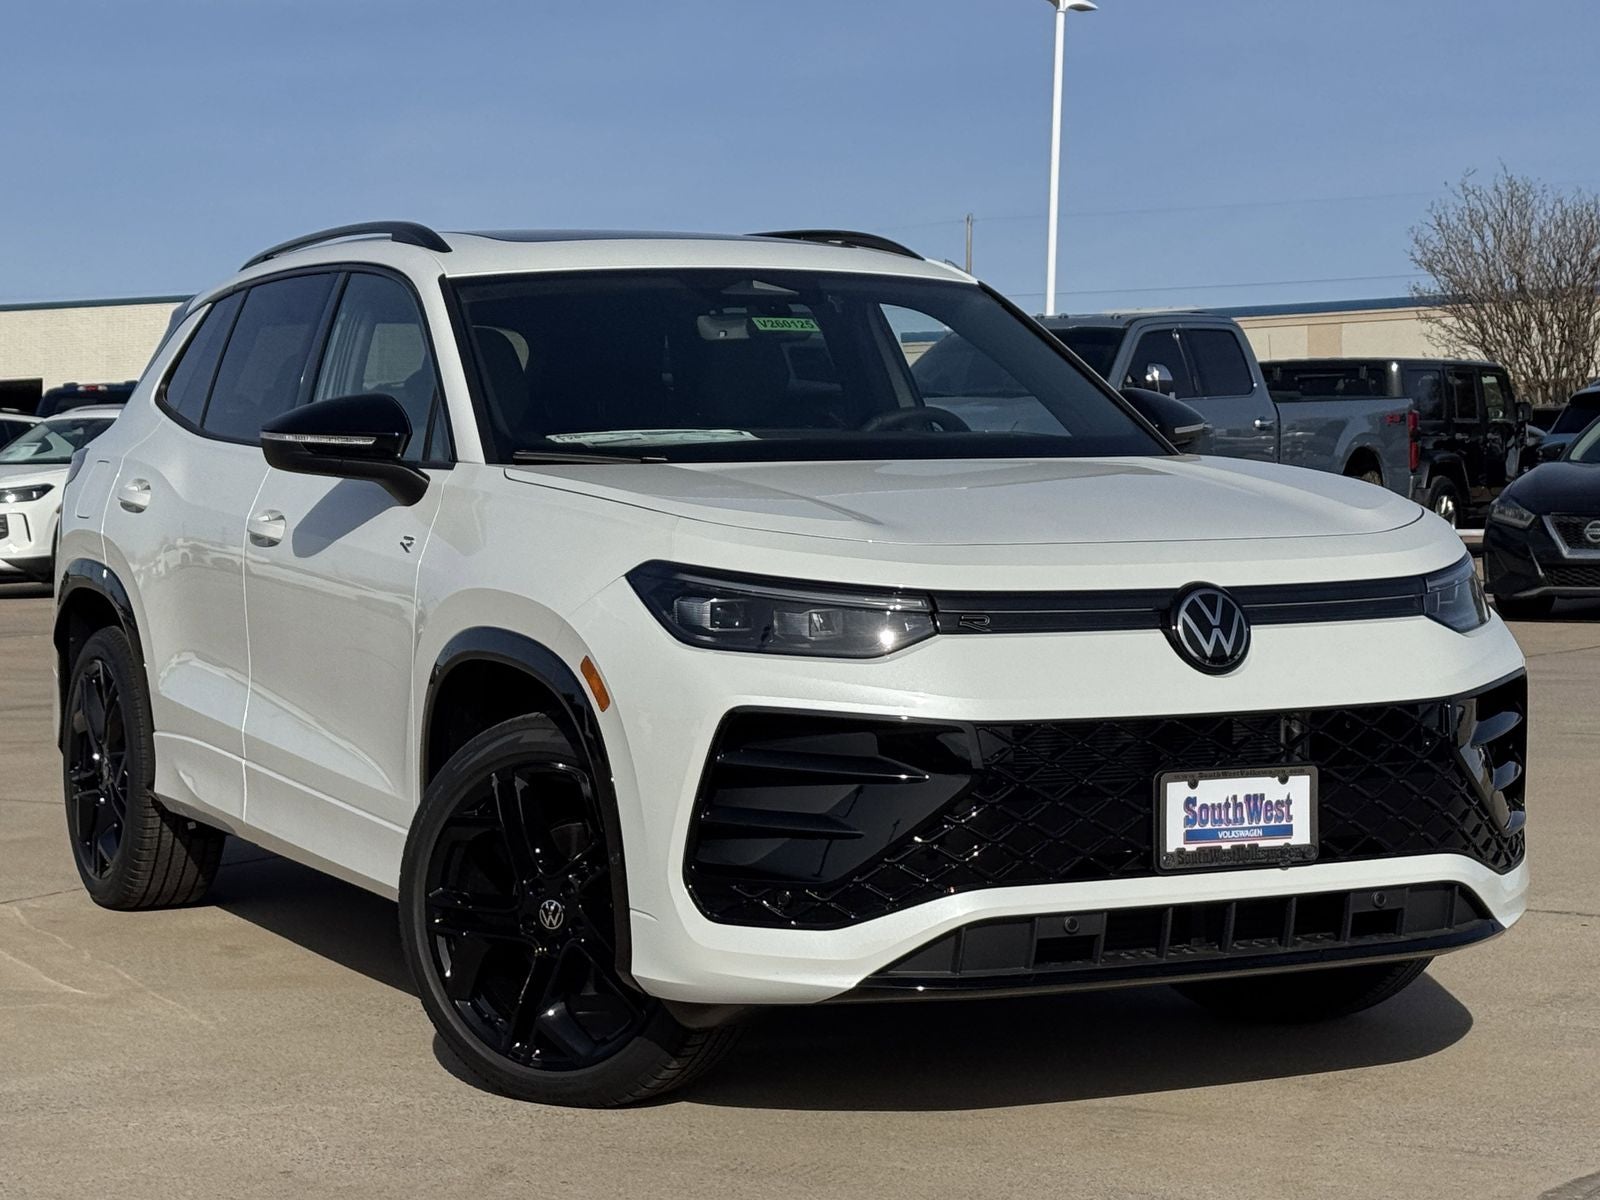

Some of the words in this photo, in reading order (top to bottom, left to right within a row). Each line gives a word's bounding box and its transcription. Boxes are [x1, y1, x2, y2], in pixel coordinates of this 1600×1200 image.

[757, 319, 814, 329] V260125
[1184, 792, 1293, 828] SouthWest
[1217, 829, 1263, 838] VOLKSWAGEN
